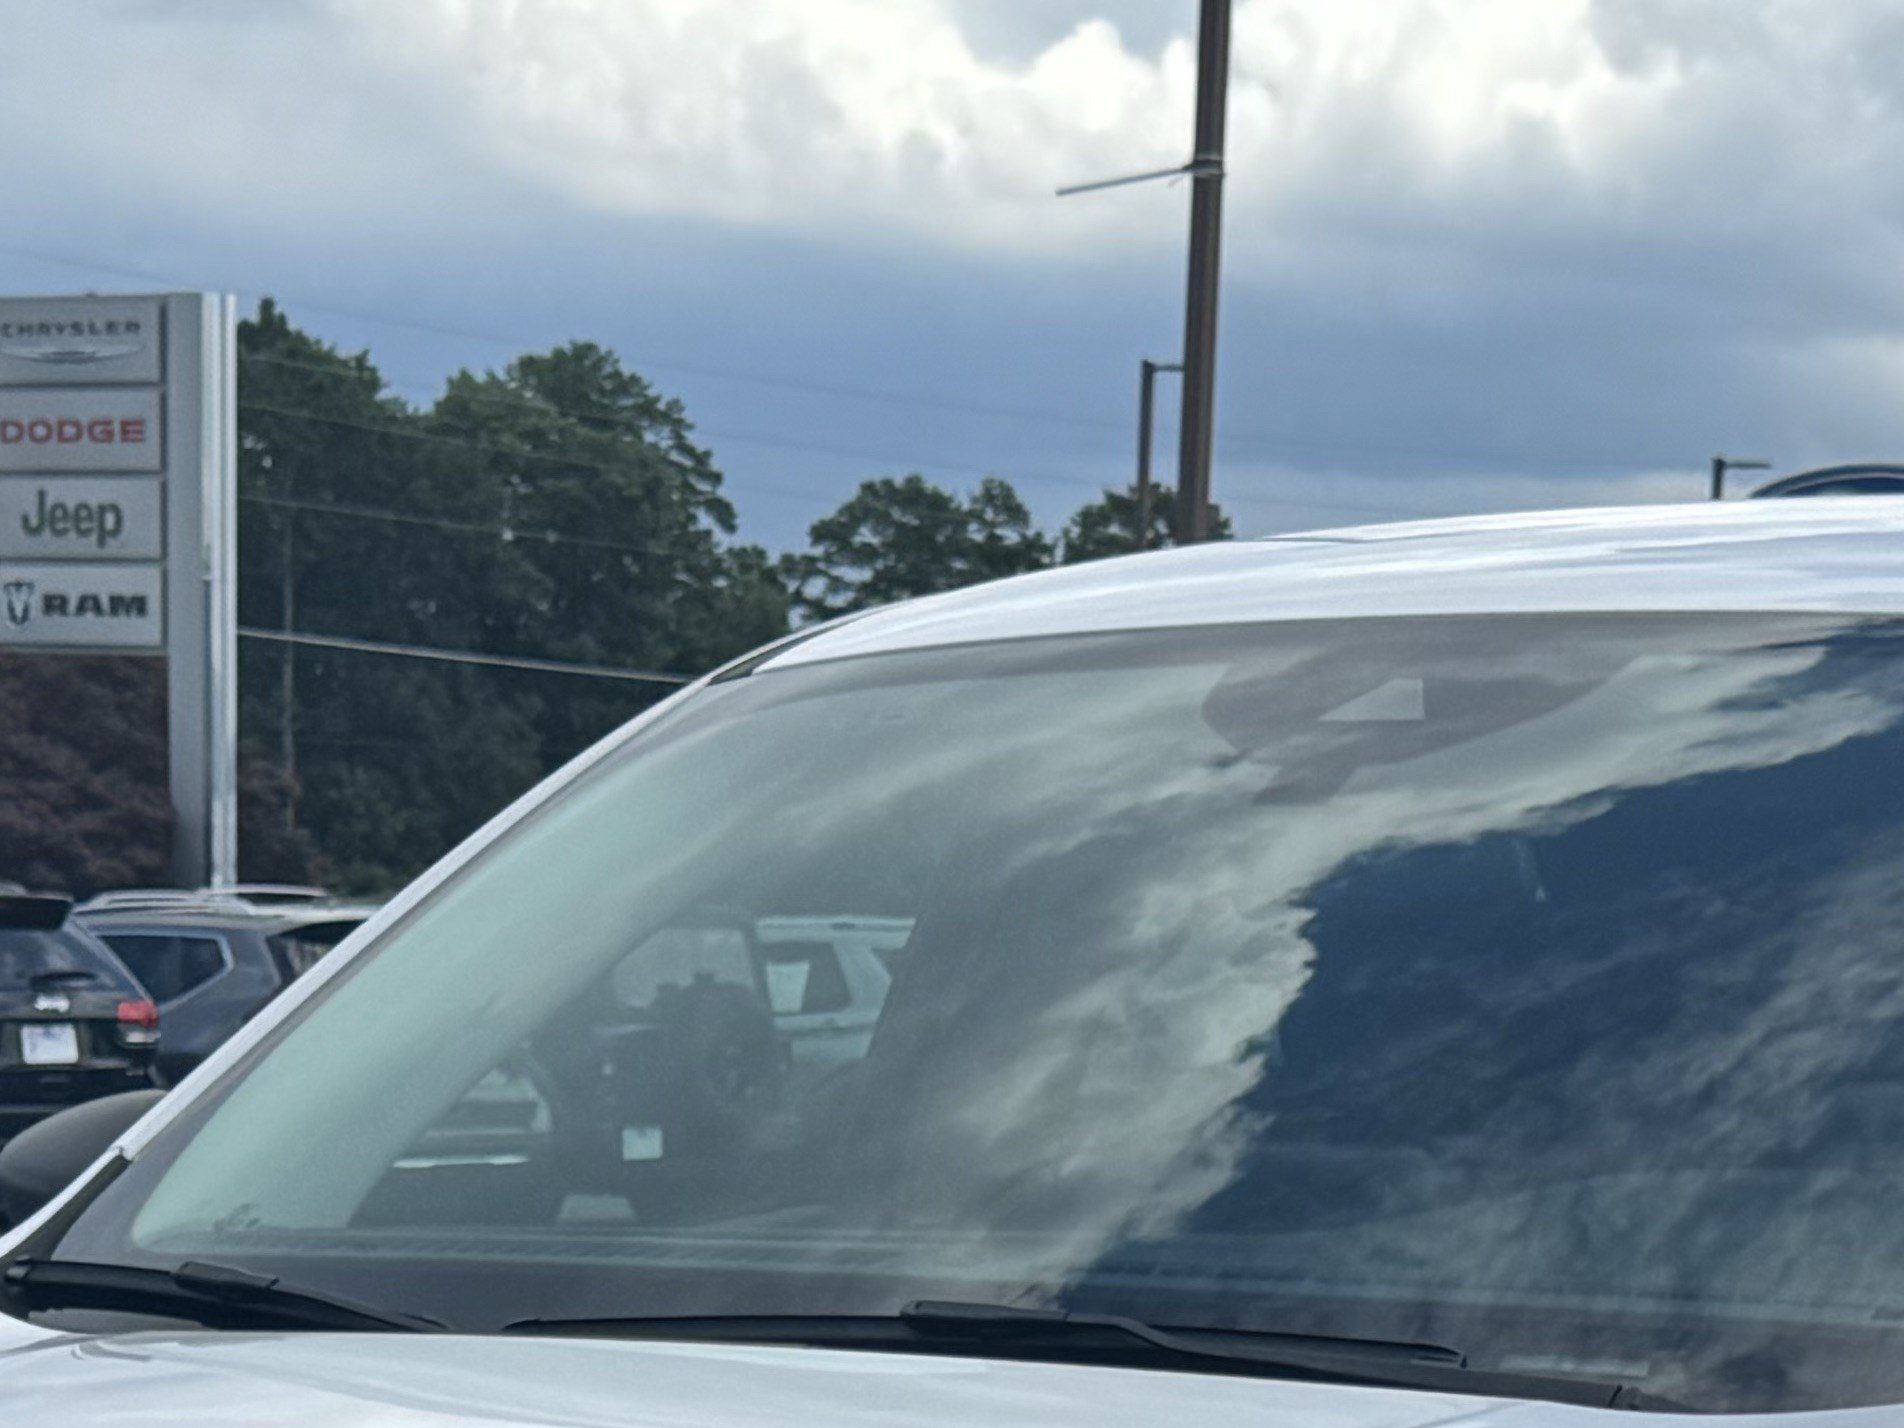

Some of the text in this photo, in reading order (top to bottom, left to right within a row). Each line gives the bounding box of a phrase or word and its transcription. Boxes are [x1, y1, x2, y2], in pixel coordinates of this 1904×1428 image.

[0, 319, 142, 339] CHRYSLER
[21, 488, 123, 548] Jeep
[42, 592, 148, 619] RAM
